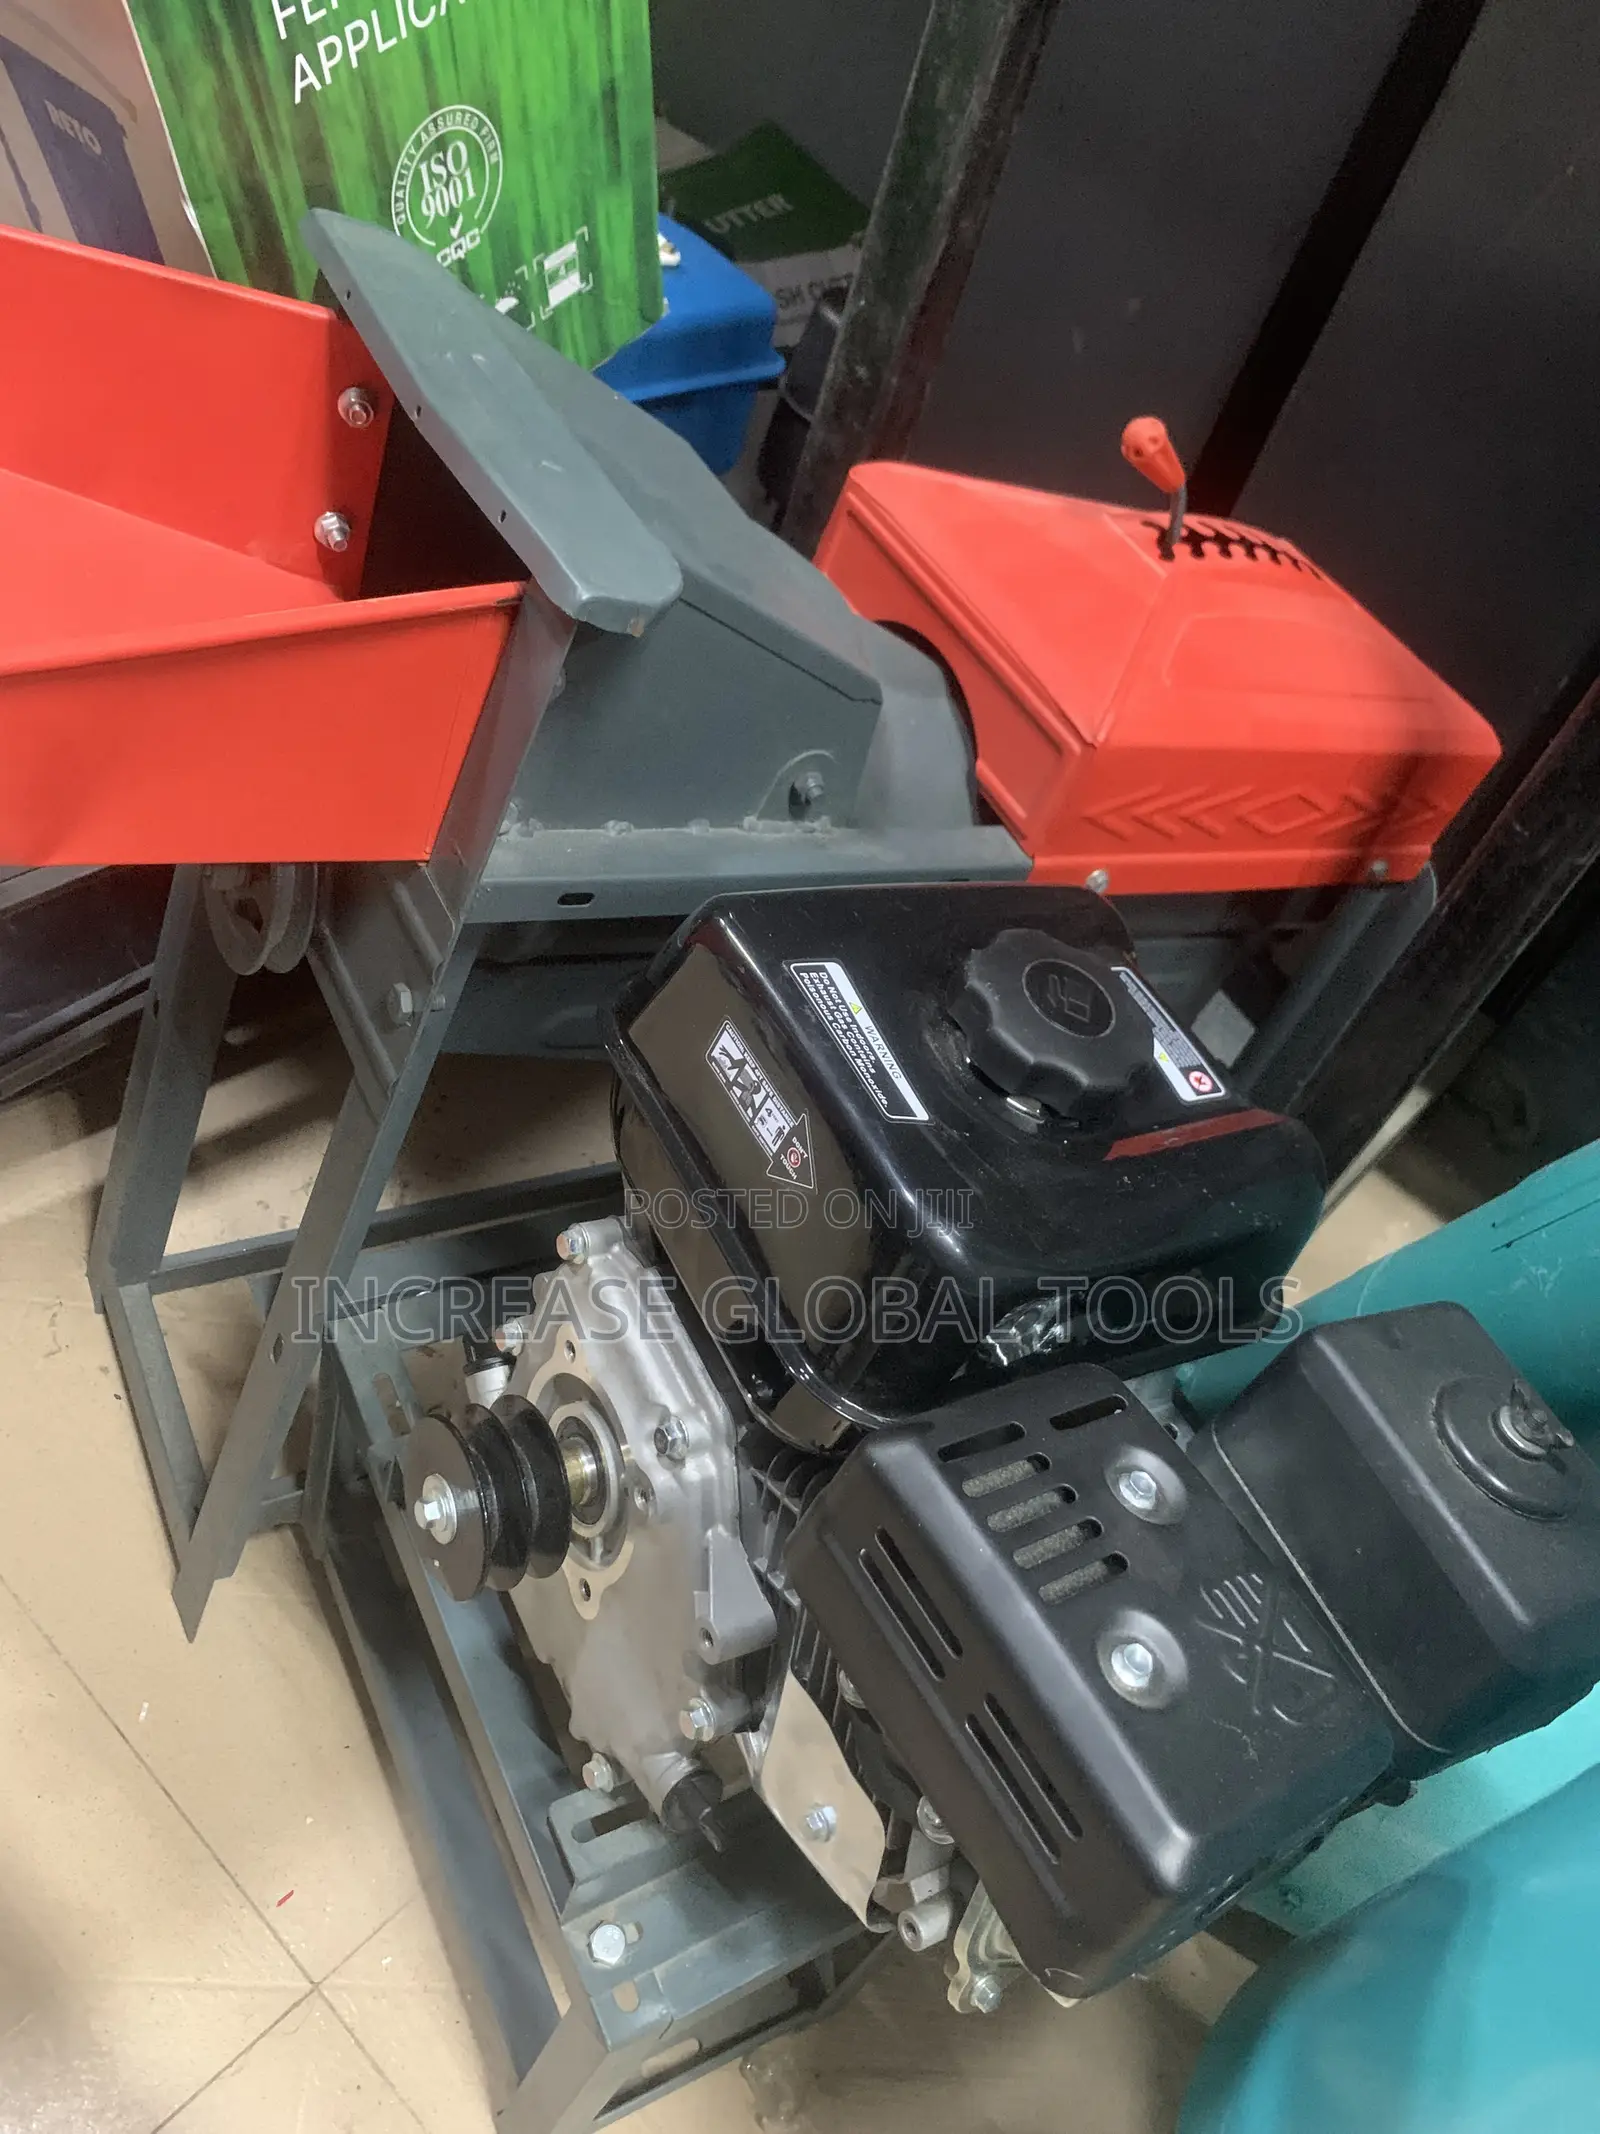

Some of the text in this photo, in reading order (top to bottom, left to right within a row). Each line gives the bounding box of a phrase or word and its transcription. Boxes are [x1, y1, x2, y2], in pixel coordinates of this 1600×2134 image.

[396, 111, 500, 225] QUALITY ASSURED FIRM
[419, 140, 469, 195] ISO
[420, 168, 477, 230] 9001
[703, 193, 795, 235] UTTER
[800, 972, 889, 1108] Poisonous Carbon Monoxide.
[809, 971, 877, 1075] Exhaust Gas Contains
[818, 971, 877, 1064] Do Not Use Indoors.
[864, 1025, 902, 1080] WARNING
[779, 1153, 798, 1181] TOUCH
[791, 1136, 808, 1160] DON'T
